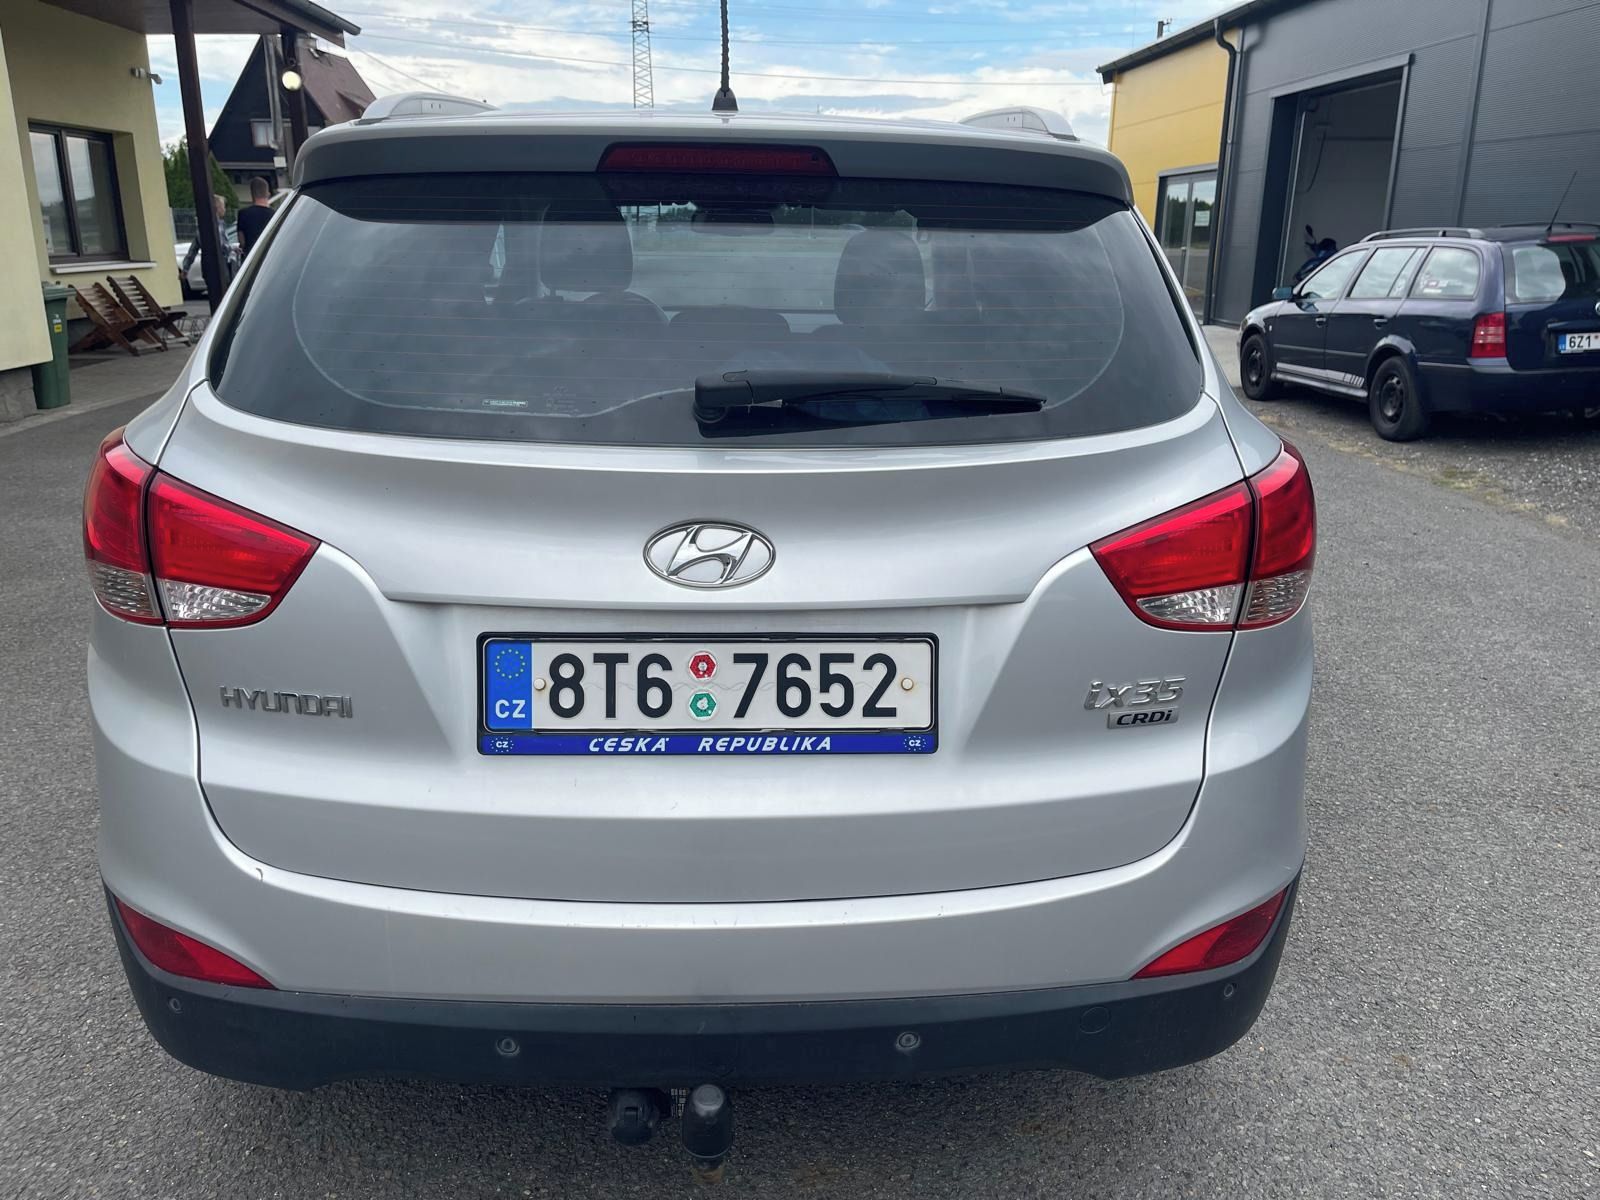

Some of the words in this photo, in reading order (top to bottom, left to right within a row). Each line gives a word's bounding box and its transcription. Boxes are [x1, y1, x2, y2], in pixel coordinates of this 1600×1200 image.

[1569, 335, 1591, 349] 6Z1
[549, 653, 673, 718] 8T6
[733, 653, 897, 718] 7652
[1084, 677, 1186, 710] ix35
[219, 686, 353, 718] HYUNDAI
[495, 700, 526, 719] CZ
[1116, 709, 1173, 725] CRDi
[495, 740, 509, 749] CZ
[589, 737, 669, 752] ČESKÁ
[698, 736, 832, 752] REPUBLIKA
[908, 738, 922, 747] CZ
